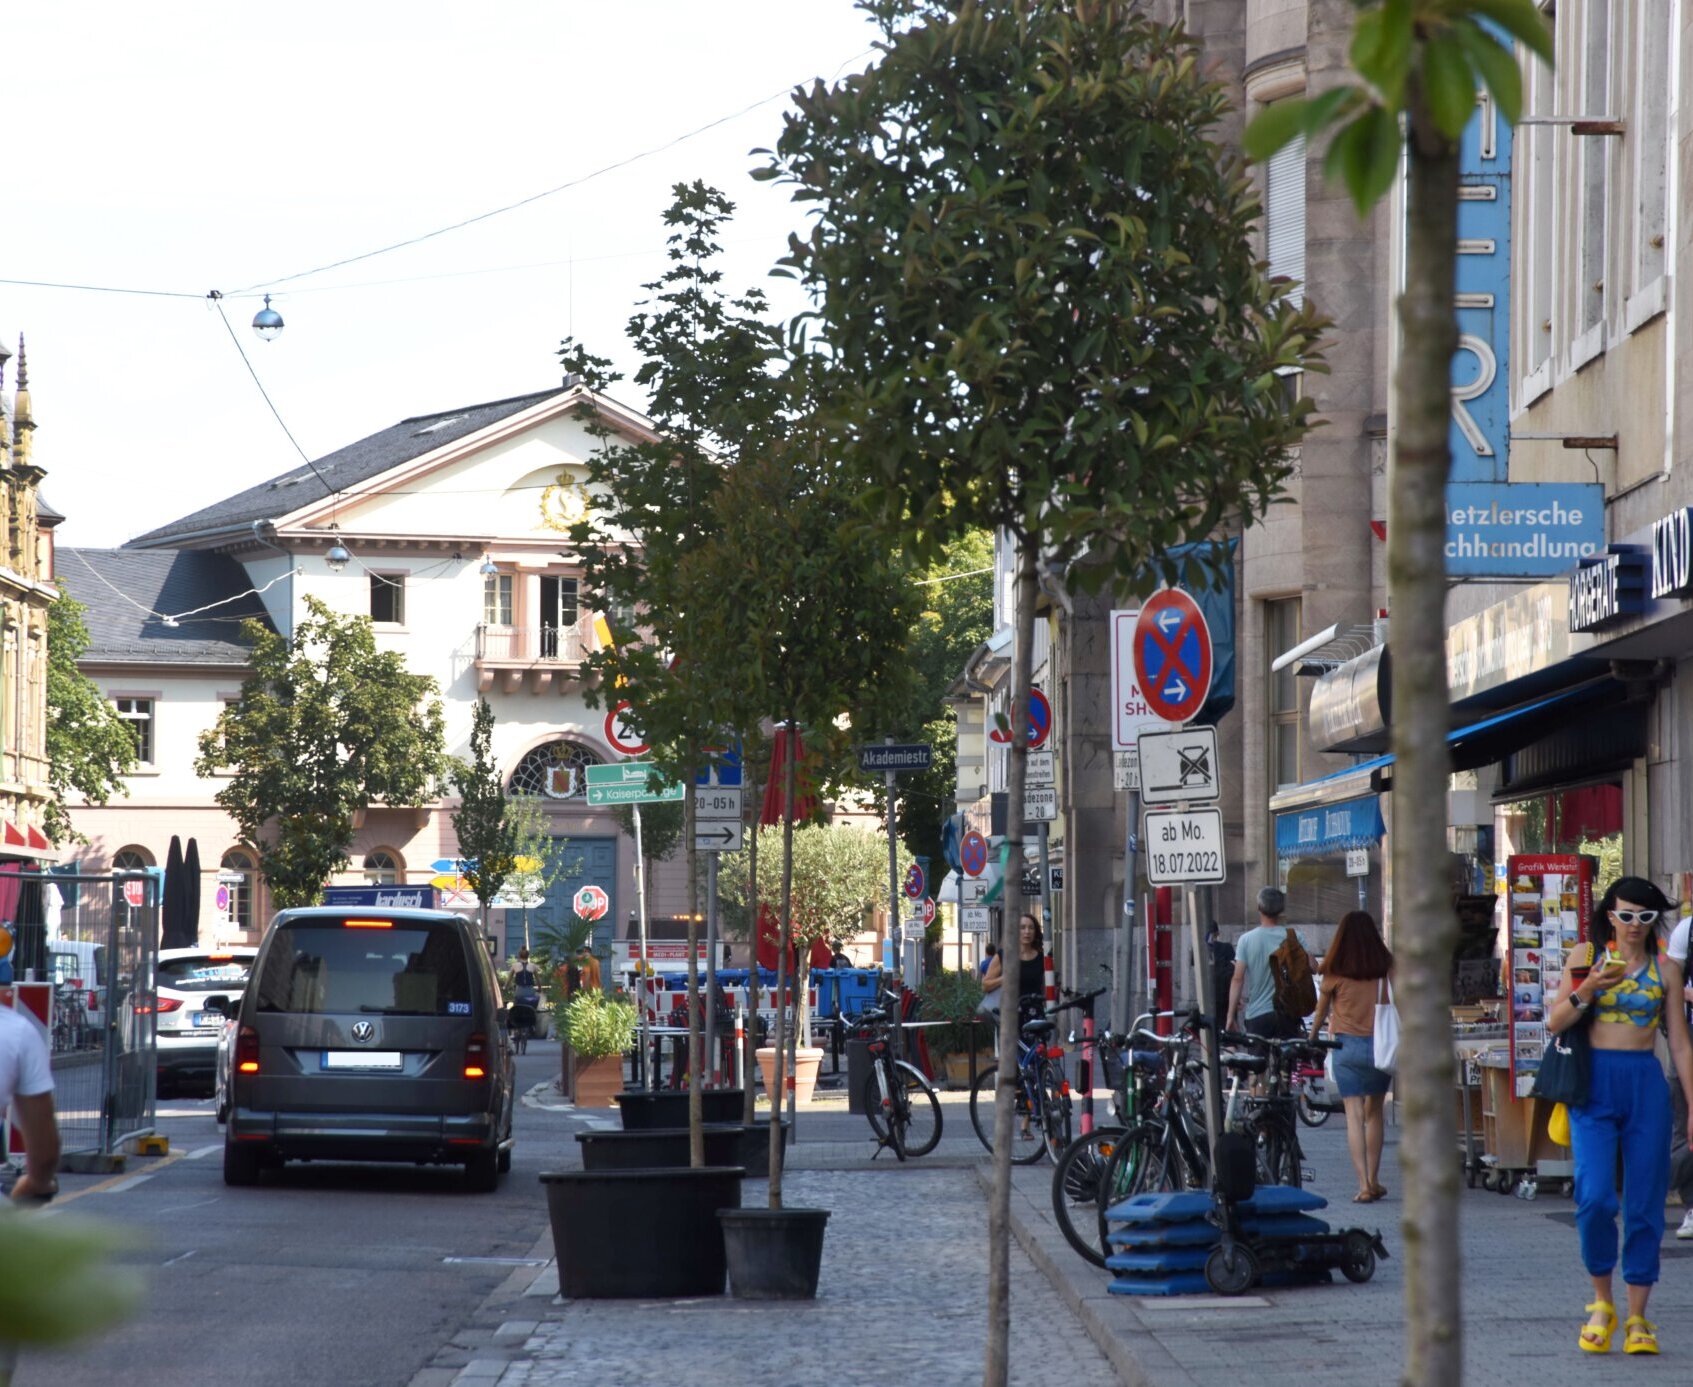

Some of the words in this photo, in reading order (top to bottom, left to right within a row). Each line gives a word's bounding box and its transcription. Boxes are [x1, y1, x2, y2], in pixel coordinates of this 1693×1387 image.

[1443, 500, 1584, 526] etzlersche
[1443, 532, 1597, 559] chhandlung
[1651, 507, 1690, 600] KIND
[862, 750, 929, 767] Akademiestr.
[606, 787, 677, 800] Kaiserpage
[1161, 821, 1177, 842] ab
[1181, 820, 1205, 841] Mo.
[1152, 851, 1219, 875] 18.07.2022
[1517, 862, 1545, 872] Grafik
[448, 1003, 470, 1013] 3173
